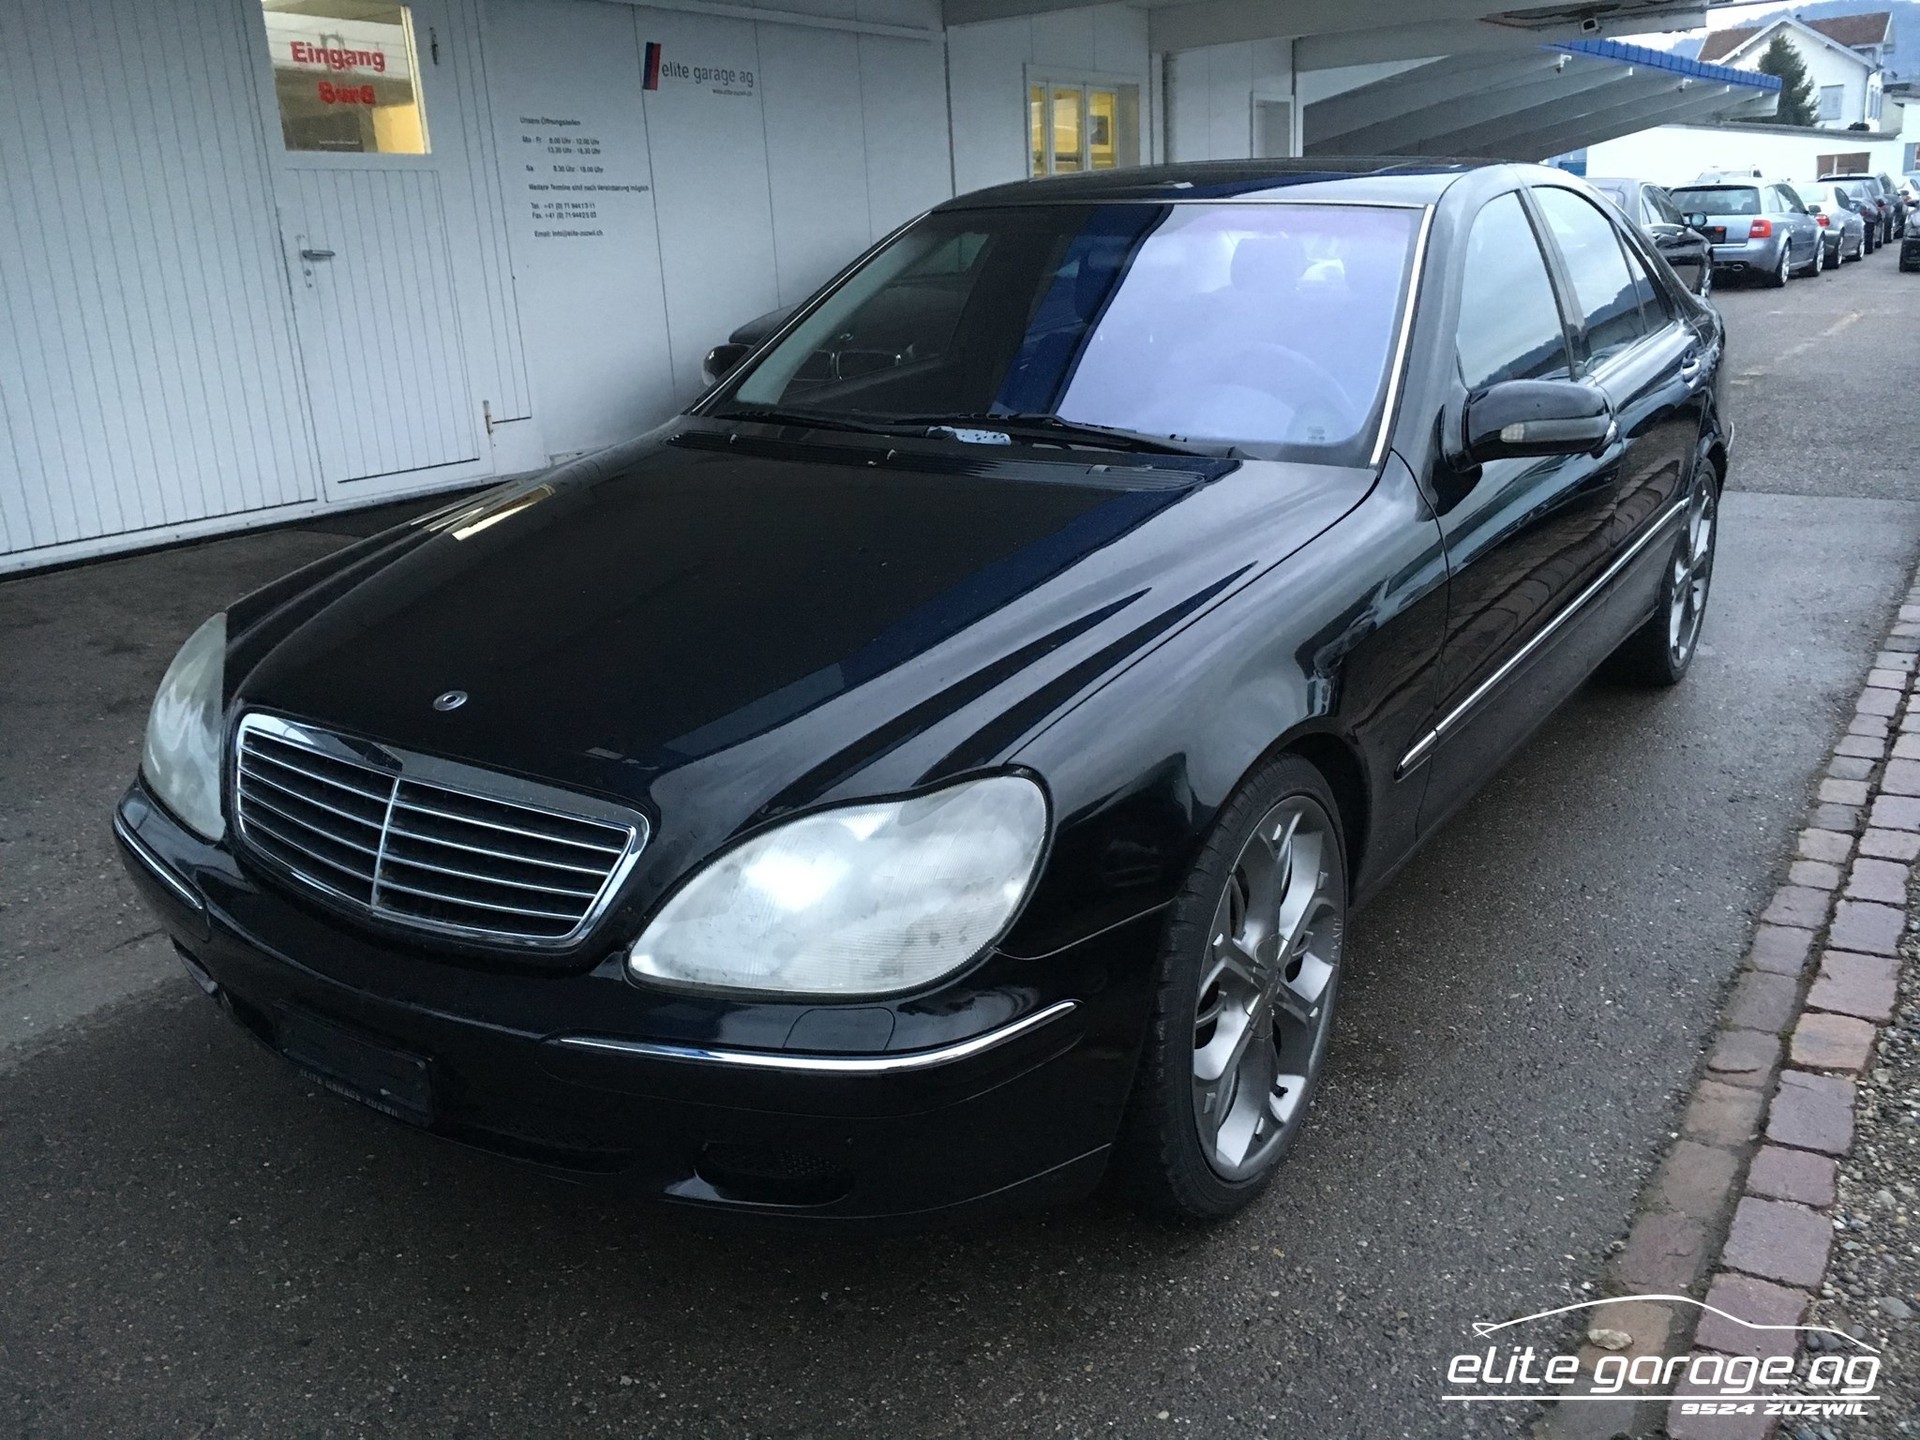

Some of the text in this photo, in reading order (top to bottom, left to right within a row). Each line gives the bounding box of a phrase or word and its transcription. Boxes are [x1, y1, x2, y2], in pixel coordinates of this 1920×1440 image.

[290, 41, 386, 73] Eingang
[662, 61, 754, 88] elite garage ag
